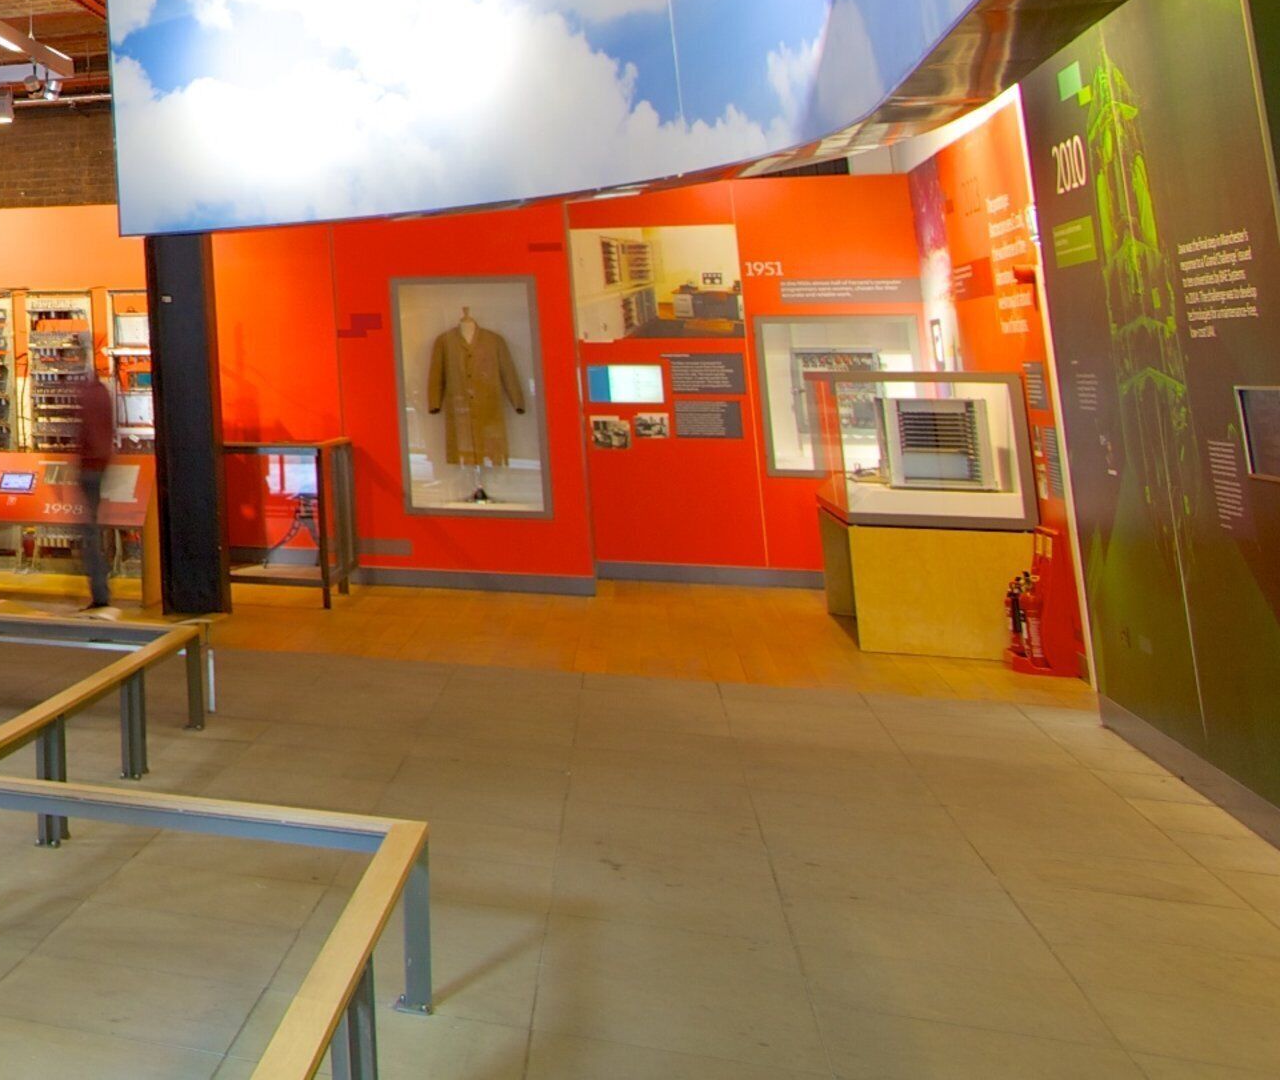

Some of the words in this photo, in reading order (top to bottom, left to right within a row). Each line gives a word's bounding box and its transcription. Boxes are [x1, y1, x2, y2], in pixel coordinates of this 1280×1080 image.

[1052, 134, 1086, 194] 2010
[745, 261, 784, 277] 1951
[43, 502, 84, 514] 1998
